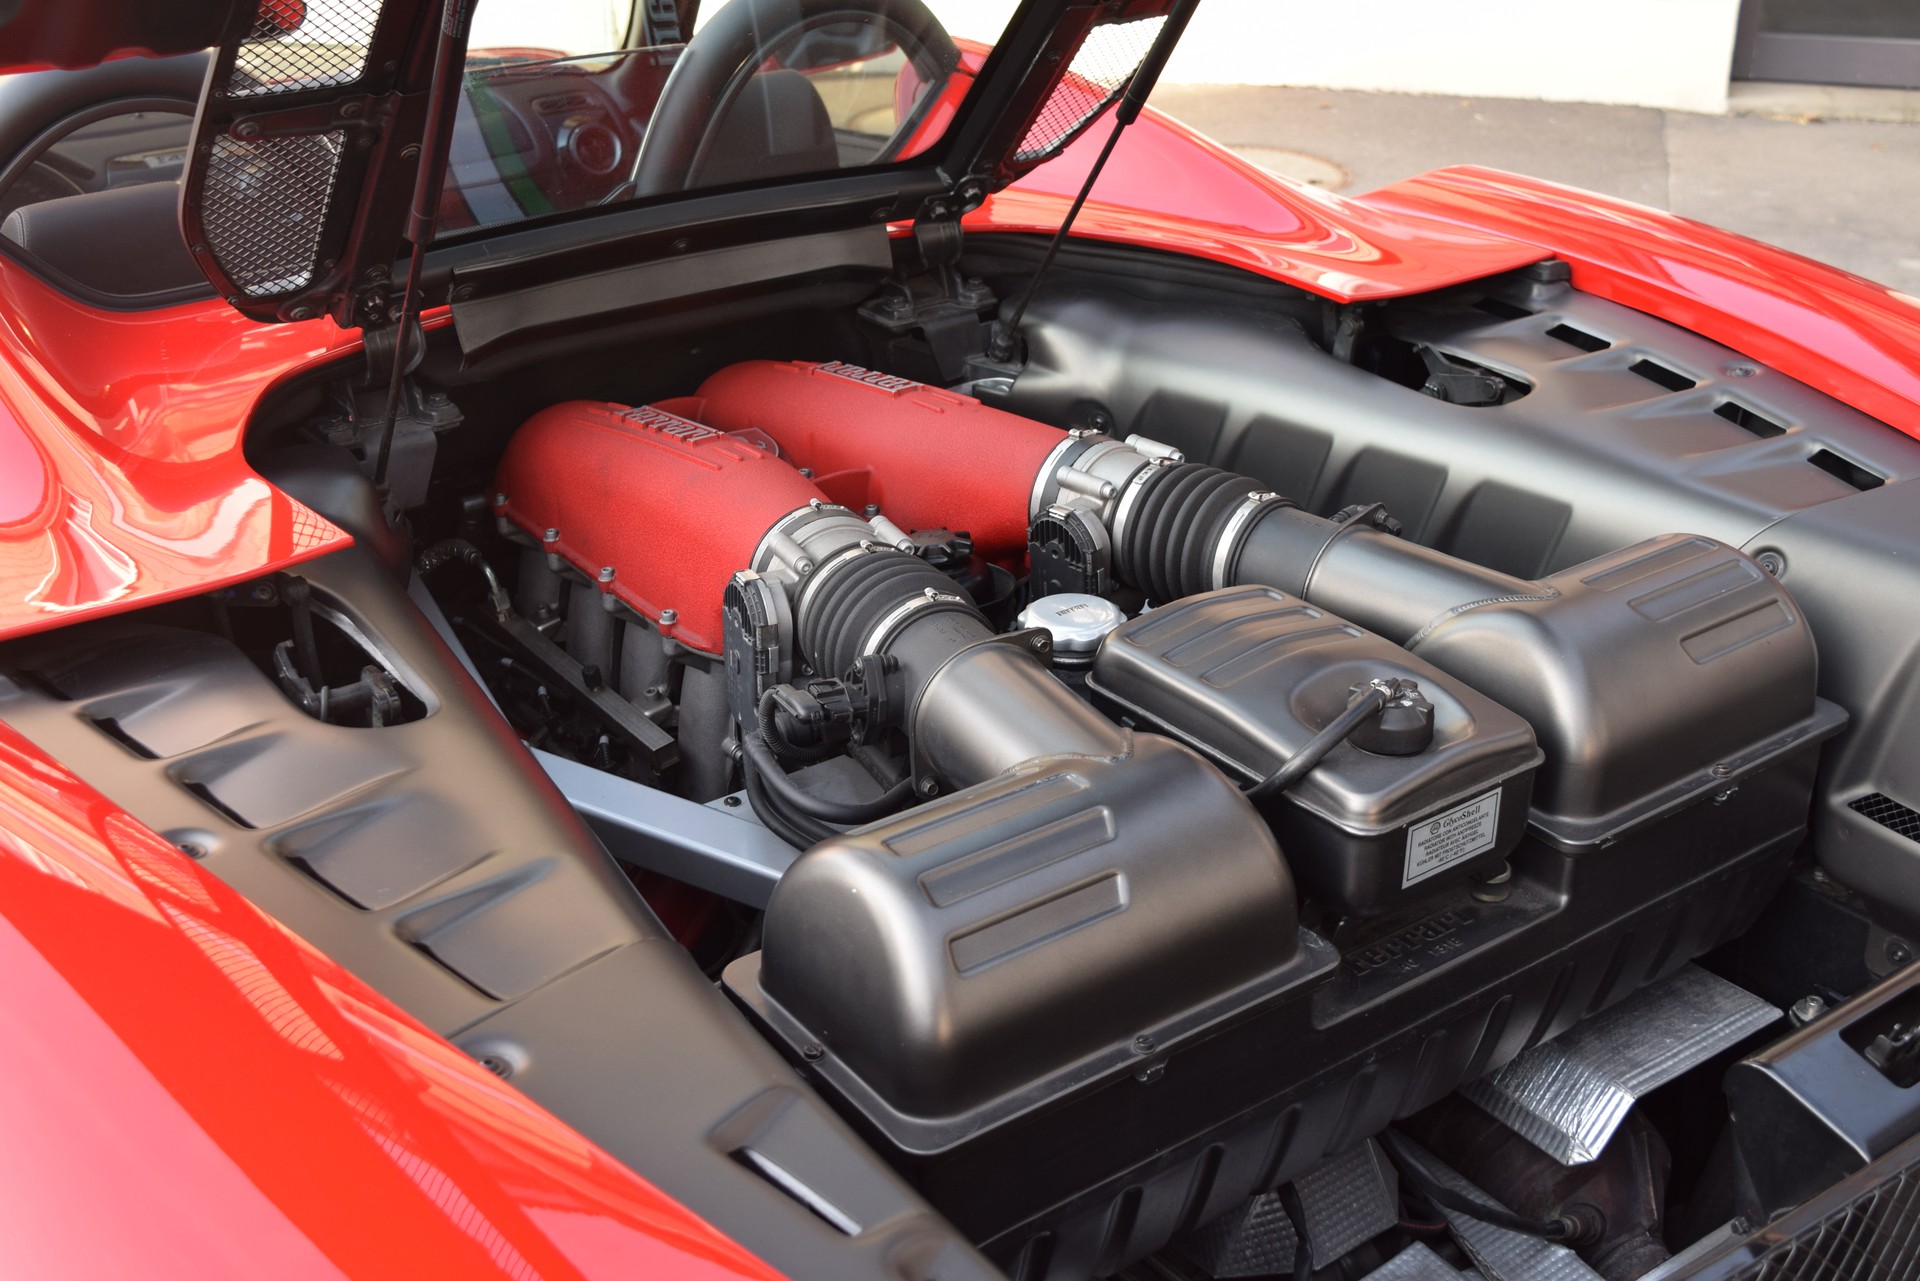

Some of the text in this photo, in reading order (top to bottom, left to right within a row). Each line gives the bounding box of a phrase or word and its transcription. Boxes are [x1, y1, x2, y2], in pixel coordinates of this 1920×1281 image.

[614, 405, 724, 444] Ferrari
[1417, 833, 1441, 846] RADIATORE
[1452, 812, 1488, 830] ANTICONGELANTE
[1442, 805, 1480, 828] GlycoShell
[1424, 838, 1445, 849] RADIATOR
[1457, 822, 1481, 834] ANTIFREEZE
[1425, 843, 1449, 855] RADIATEUR
[1461, 829, 1478, 839] ANTIGEL
[1442, 832, 1485, 854] FROSTSCHUTZMITTEL
